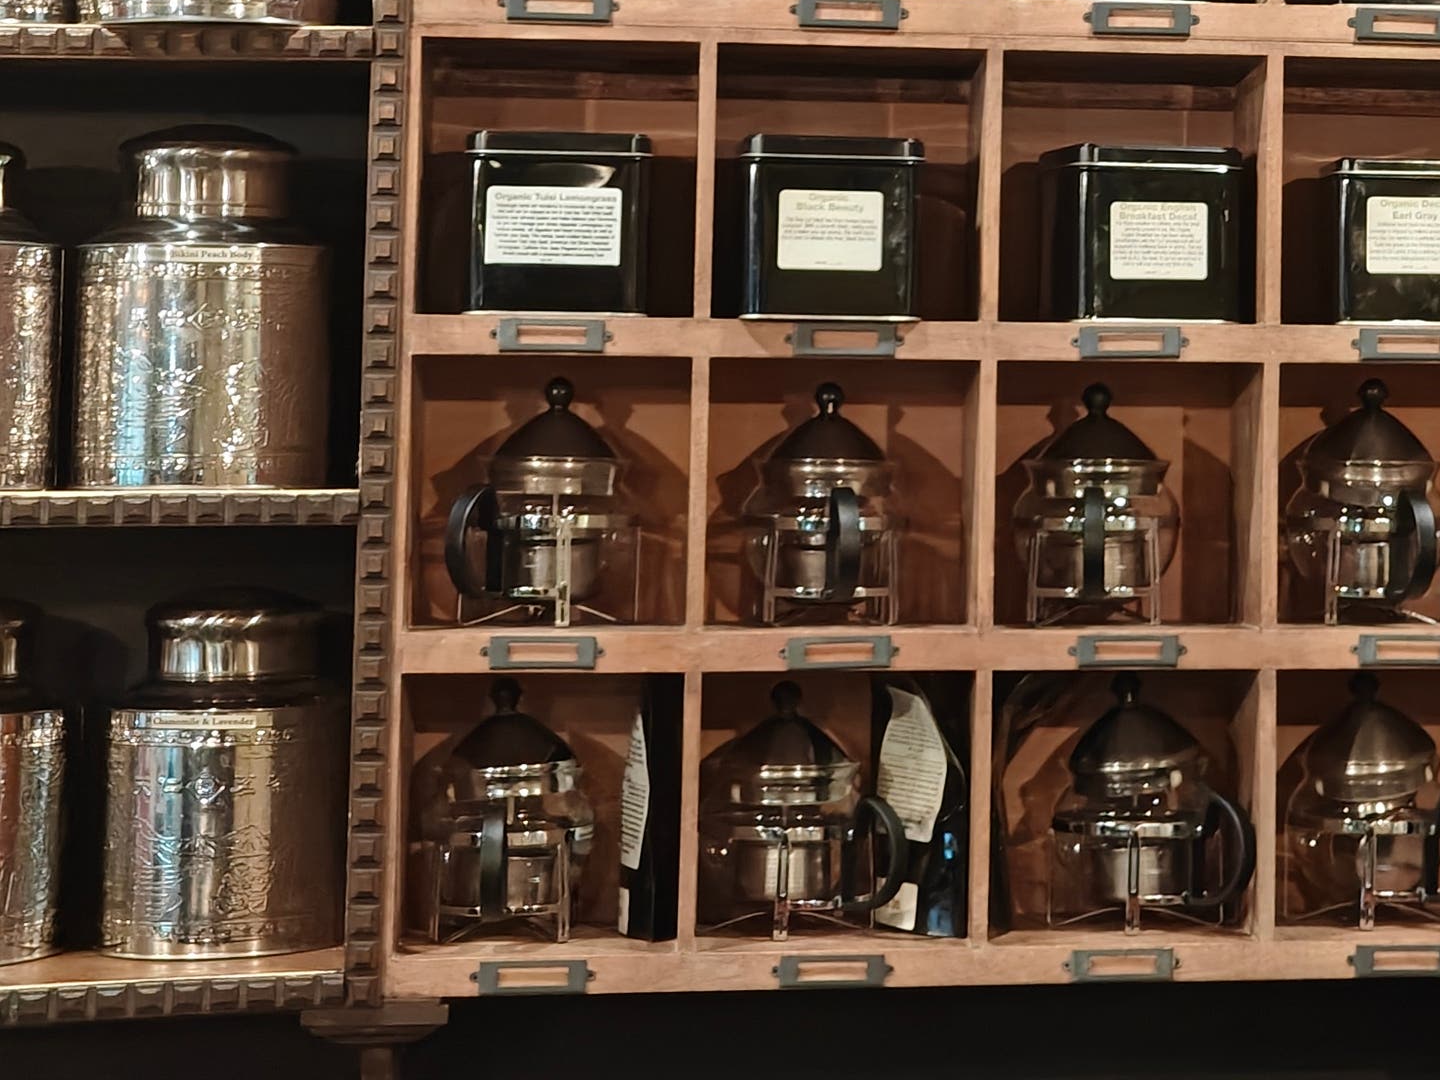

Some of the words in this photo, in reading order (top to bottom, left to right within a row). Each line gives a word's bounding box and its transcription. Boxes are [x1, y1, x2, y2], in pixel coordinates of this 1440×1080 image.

[495, 192, 532, 203] Organic
[1379, 199, 1420, 209] Organic
[1119, 212, 1167, 220] Breakfast
[1392, 211, 1412, 220] Earl
[200, 250, 229, 258] Peach
[212, 717, 254, 725] Lavender
